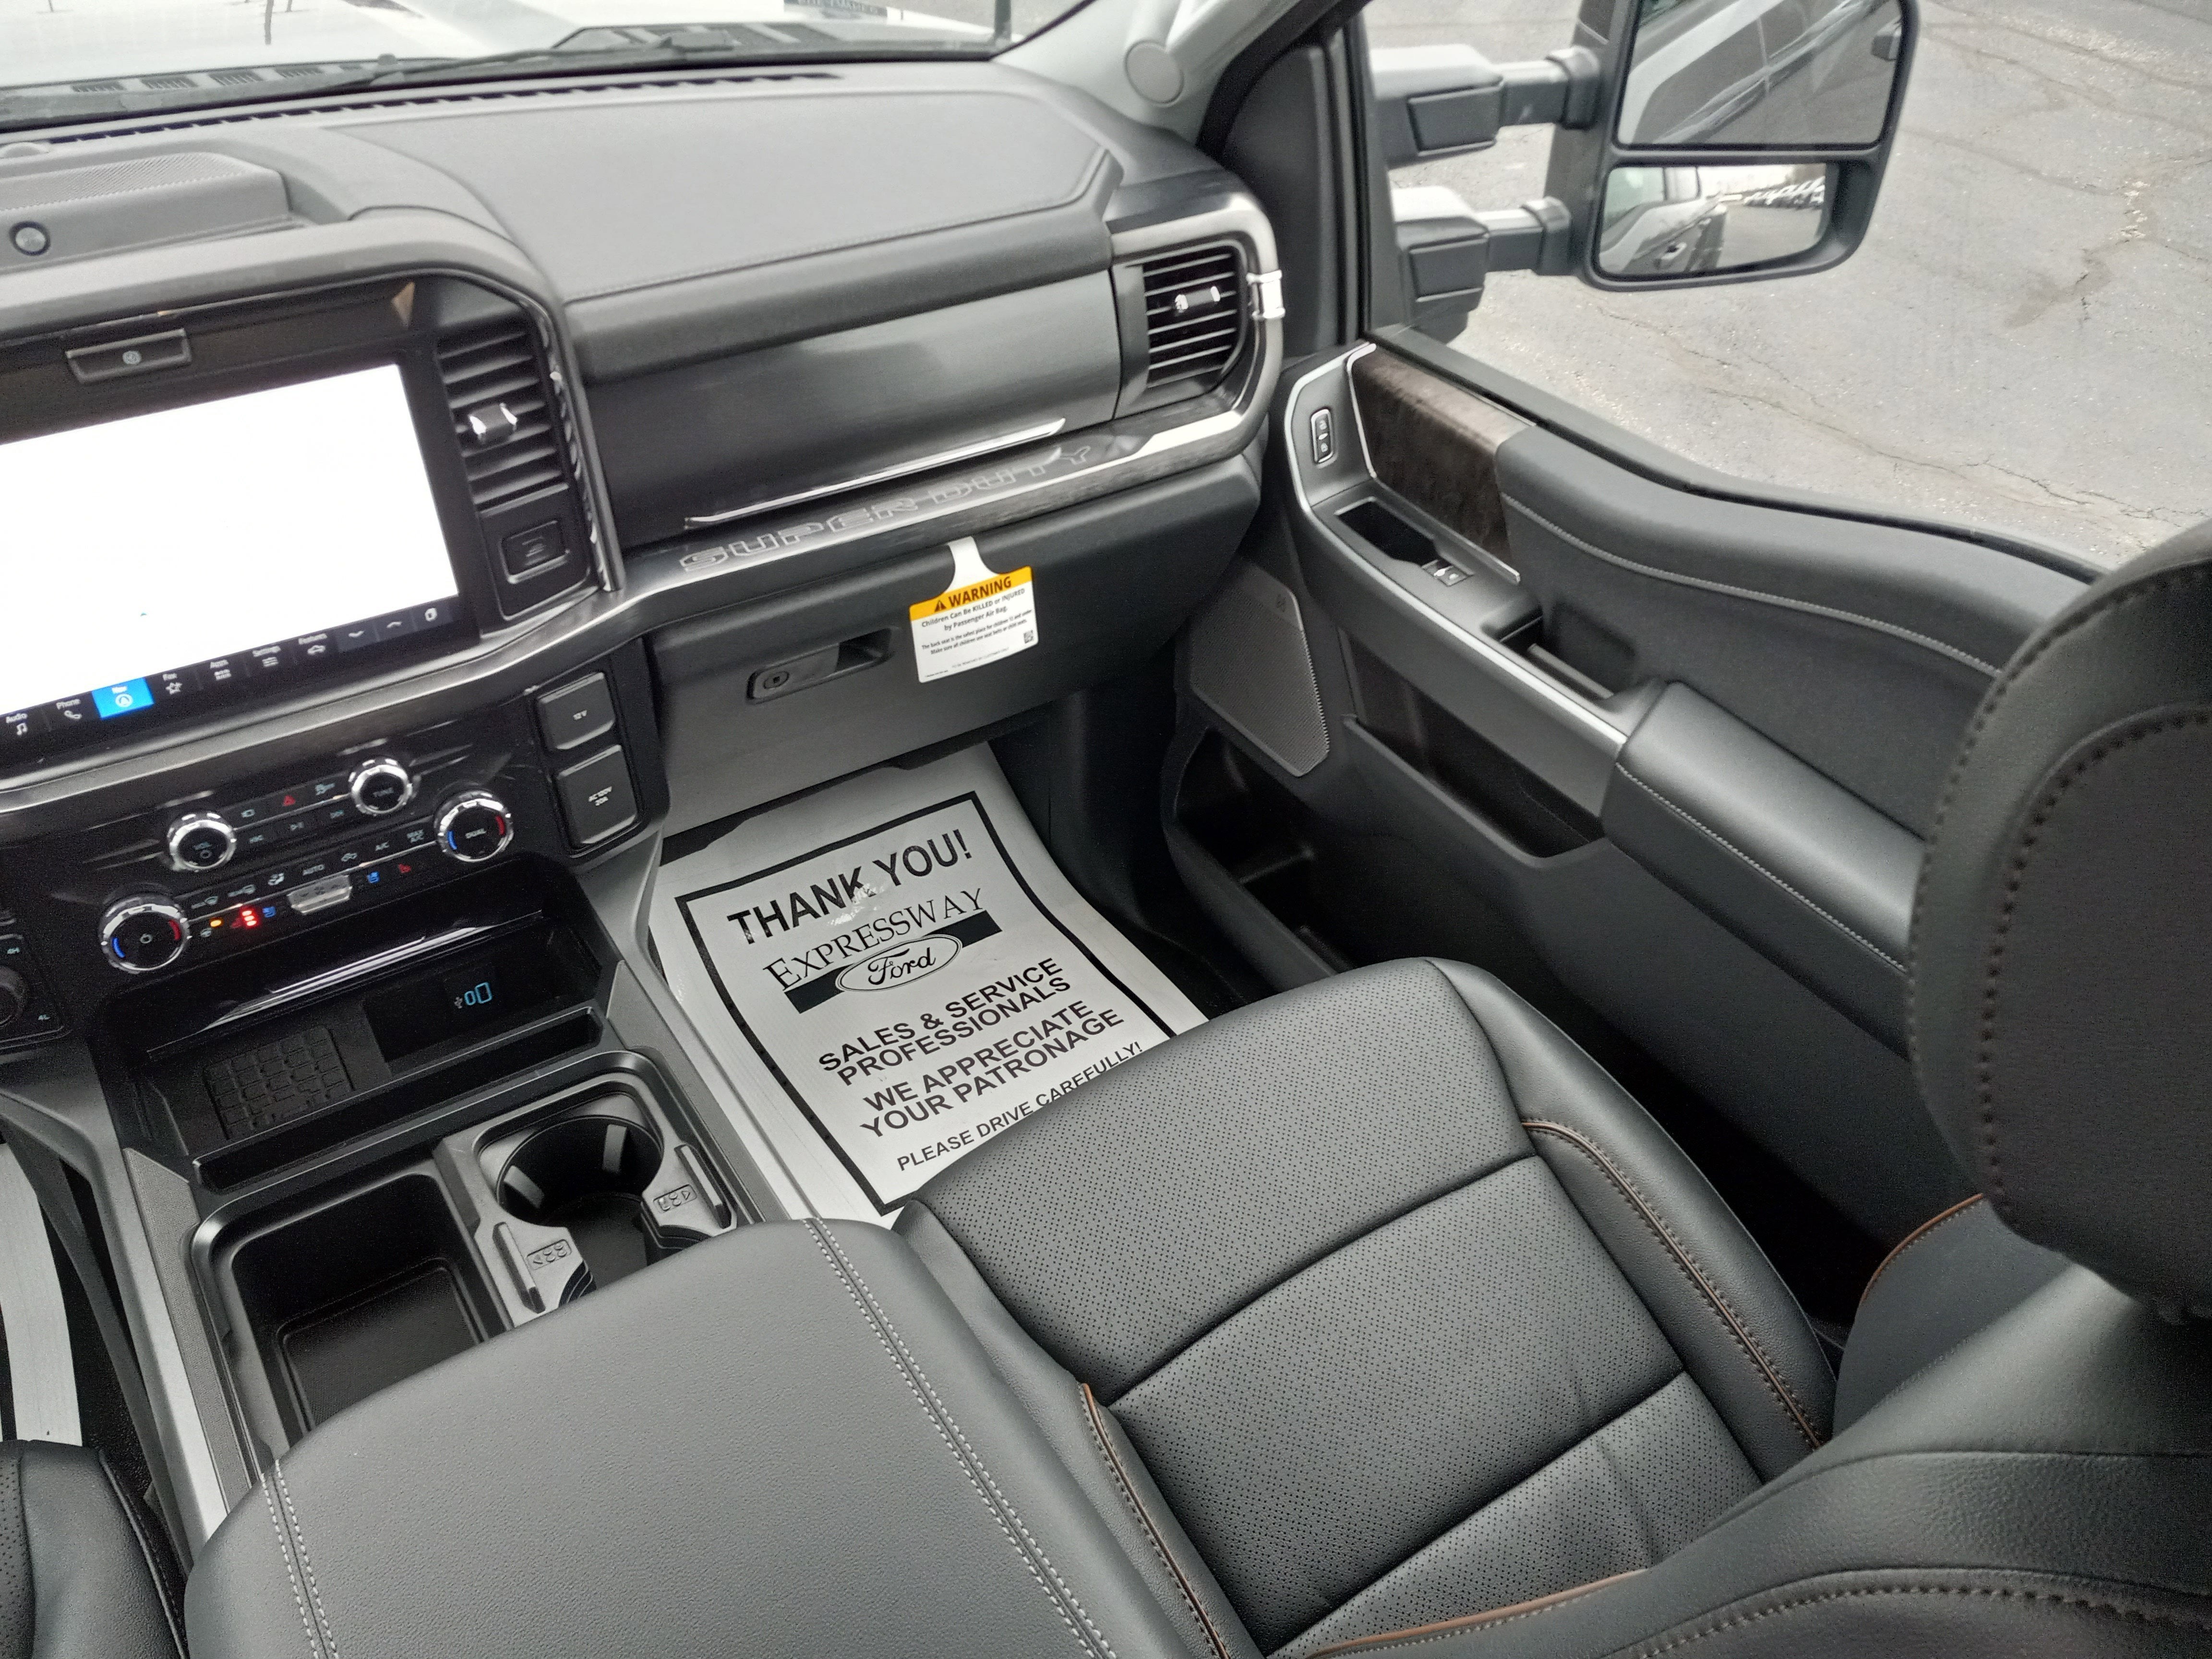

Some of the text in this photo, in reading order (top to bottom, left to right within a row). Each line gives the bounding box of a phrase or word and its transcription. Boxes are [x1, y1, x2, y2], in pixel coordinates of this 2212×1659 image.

[679, 445, 1092, 572] SUPER DUTY
[922, 616, 949, 627] Children
[973, 601, 993, 612] KILLED
[1001, 588, 1025, 601] INJURED
[948, 576, 1011, 607] WARNING
[953, 614, 984, 627] Passenger
[6, 713, 28, 723] Audio
[56, 699, 81, 709] Phone
[302, 864, 325, 876] AUTO
[727, 829, 973, 945] THANK YOU!
[762, 888, 984, 992] EXPRESSWAY
[866, 947, 936, 986] Ford
[819, 957, 1063, 1073] SALES & SERVICE
[836, 976, 1071, 1086] PROFESSIONALS
[859, 1008, 1125, 1139] YOUR PATRONAGE
[863, 999, 1094, 1112] WE APPRECIATE
[897, 1130, 975, 1171] PLEASE
[976, 1100, 1034, 1138] DRIVE
